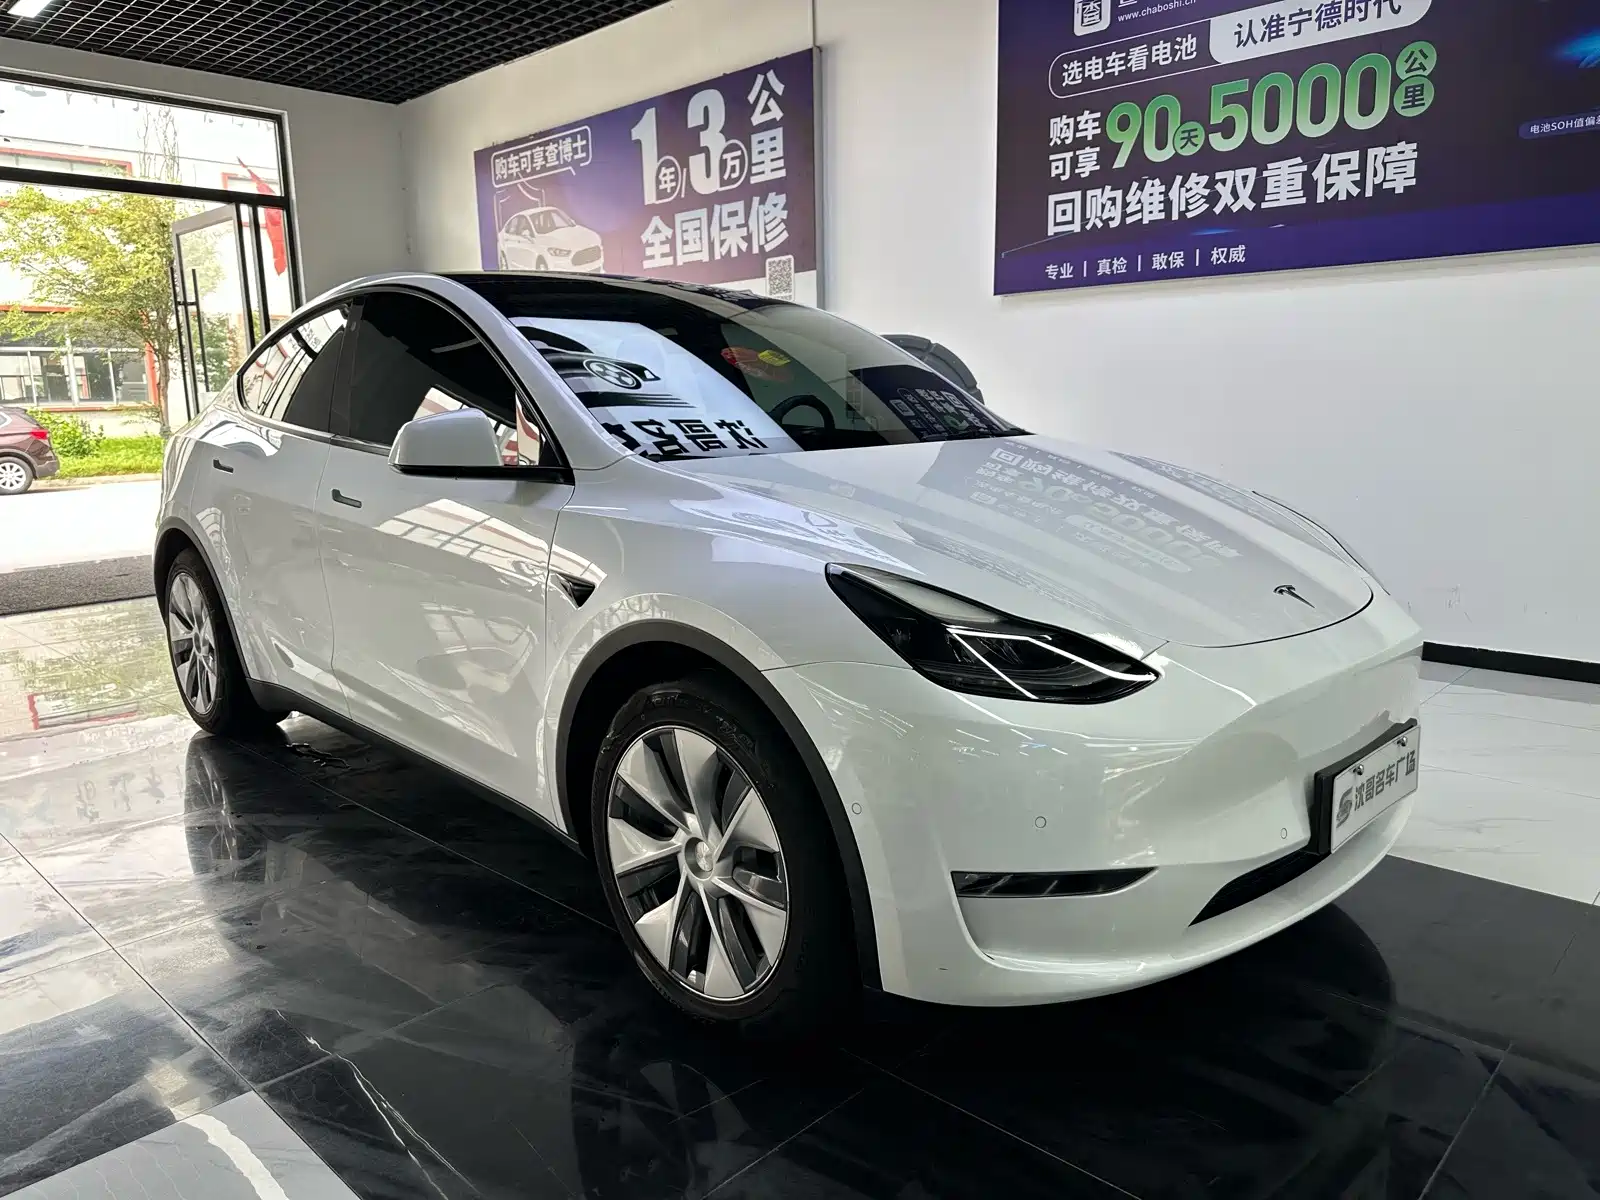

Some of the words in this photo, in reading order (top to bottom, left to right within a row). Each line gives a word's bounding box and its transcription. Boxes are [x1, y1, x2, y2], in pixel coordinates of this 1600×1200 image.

[1234, 0, 1402, 48] 认准宁德时代
[1062, 33, 1197, 87] 选电车看电池
[1049, 110, 1101, 147] 购车
[494, 134, 587, 180] 购车可享查博士
[1049, 147, 1101, 181] 可享
[1047, 141, 1419, 236] 回购维修双重保障
[641, 192, 790, 270] 全国保修
[1045, 264, 1075, 280] 专业
[1097, 257, 1128, 276] 真检
[1152, 251, 1185, 270] 敢保
[1211, 244, 1246, 265] 权威
[1354, 750, 1416, 812] 沈哥名车广场
